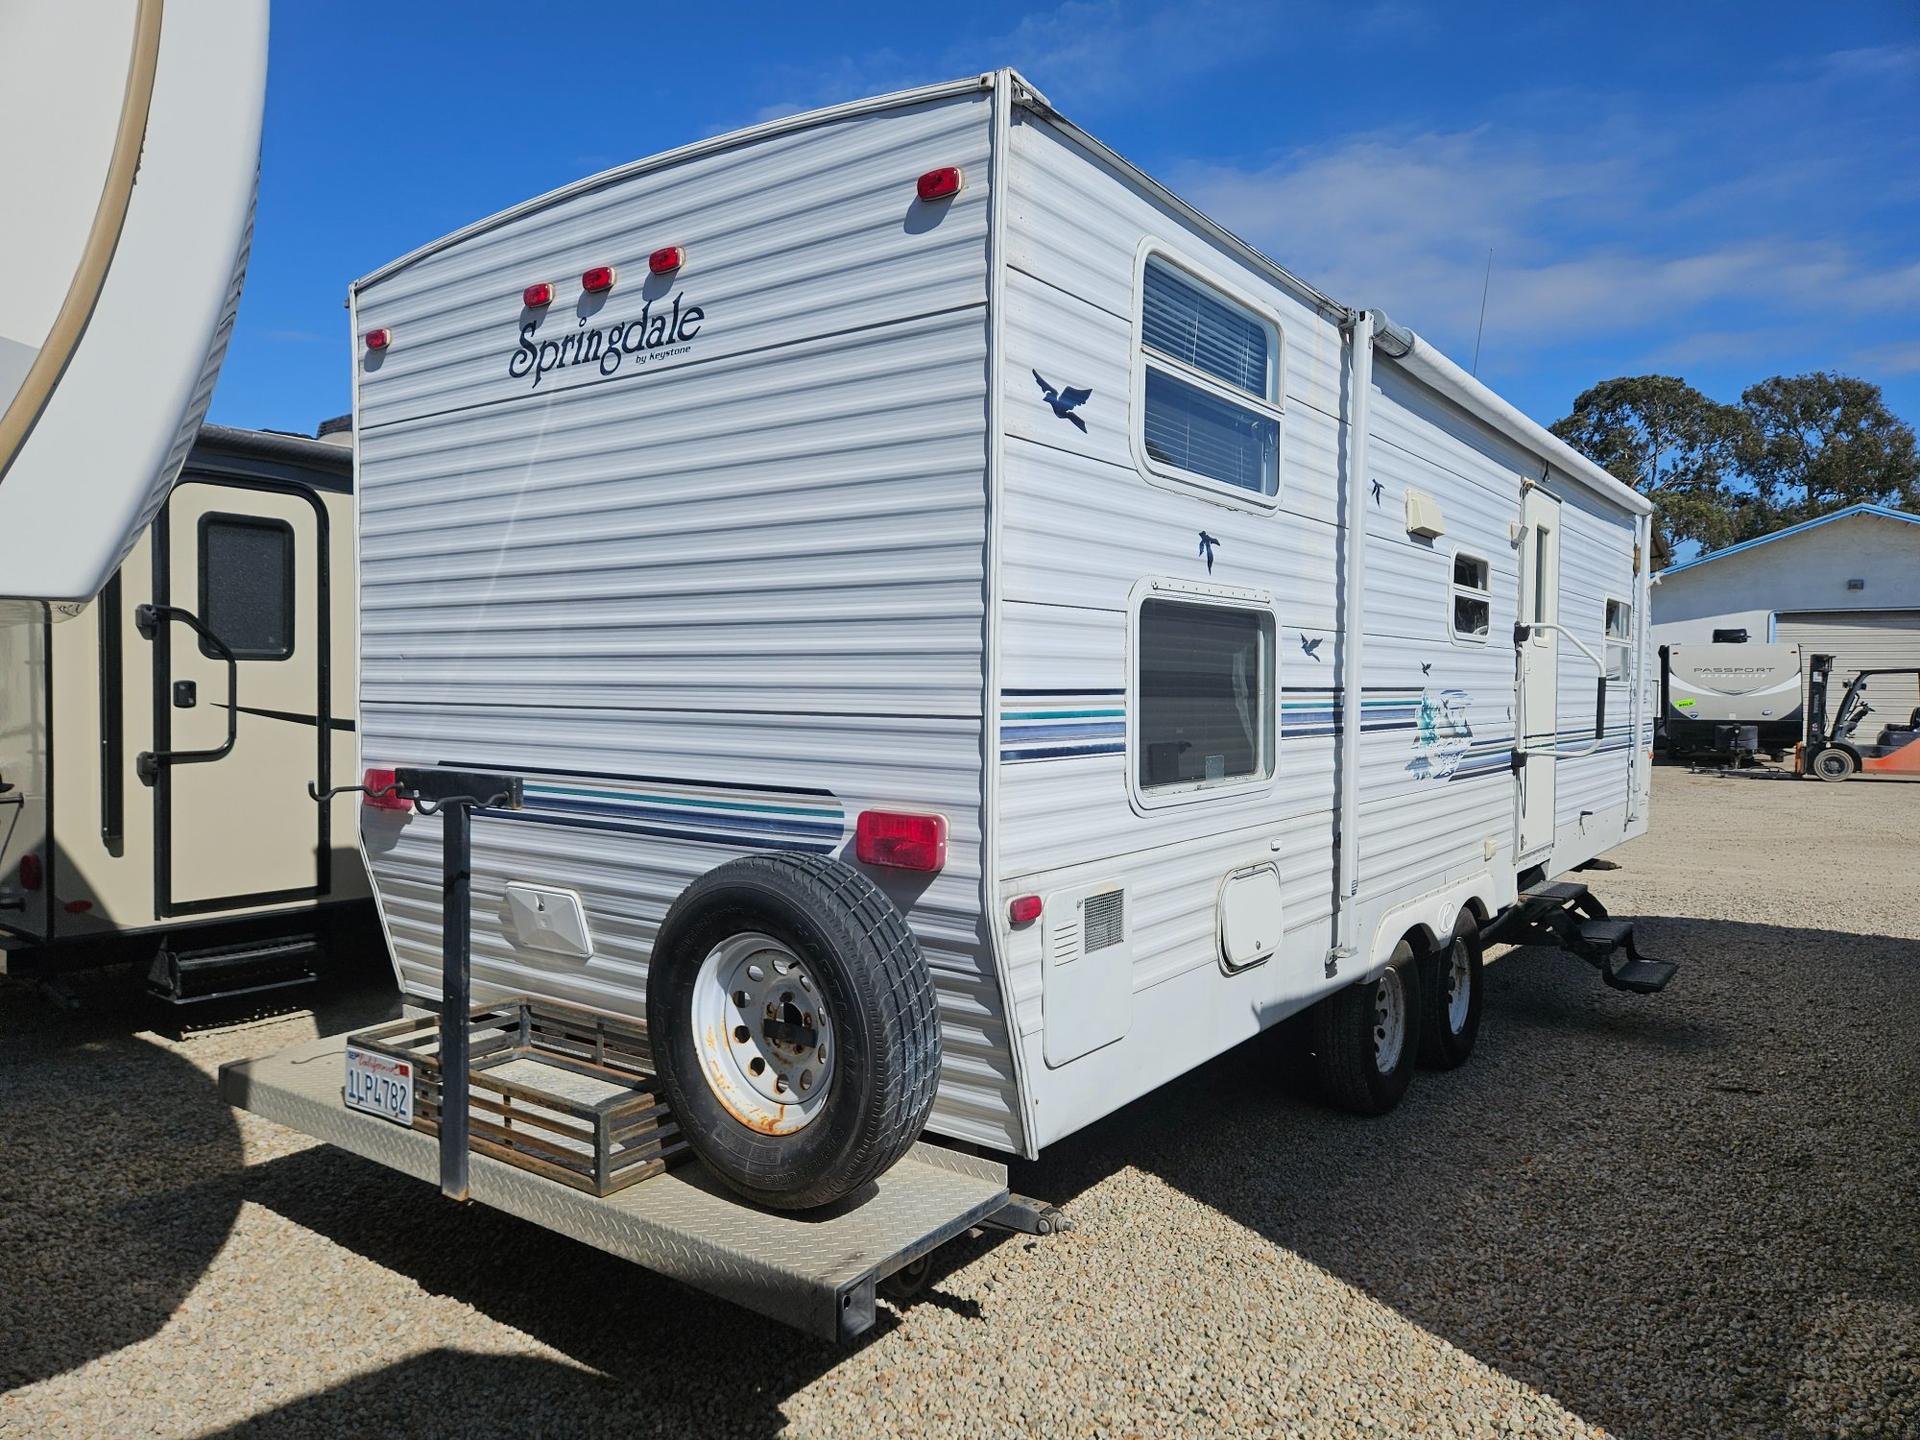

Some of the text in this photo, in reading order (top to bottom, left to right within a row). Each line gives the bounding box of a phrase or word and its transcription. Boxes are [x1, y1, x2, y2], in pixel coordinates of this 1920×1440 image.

[508, 291, 705, 389] Springdale
[635, 346, 691, 365] by Keystone
[358, 1053, 396, 1073] California
[348, 1069, 407, 1116] 1LP4782
